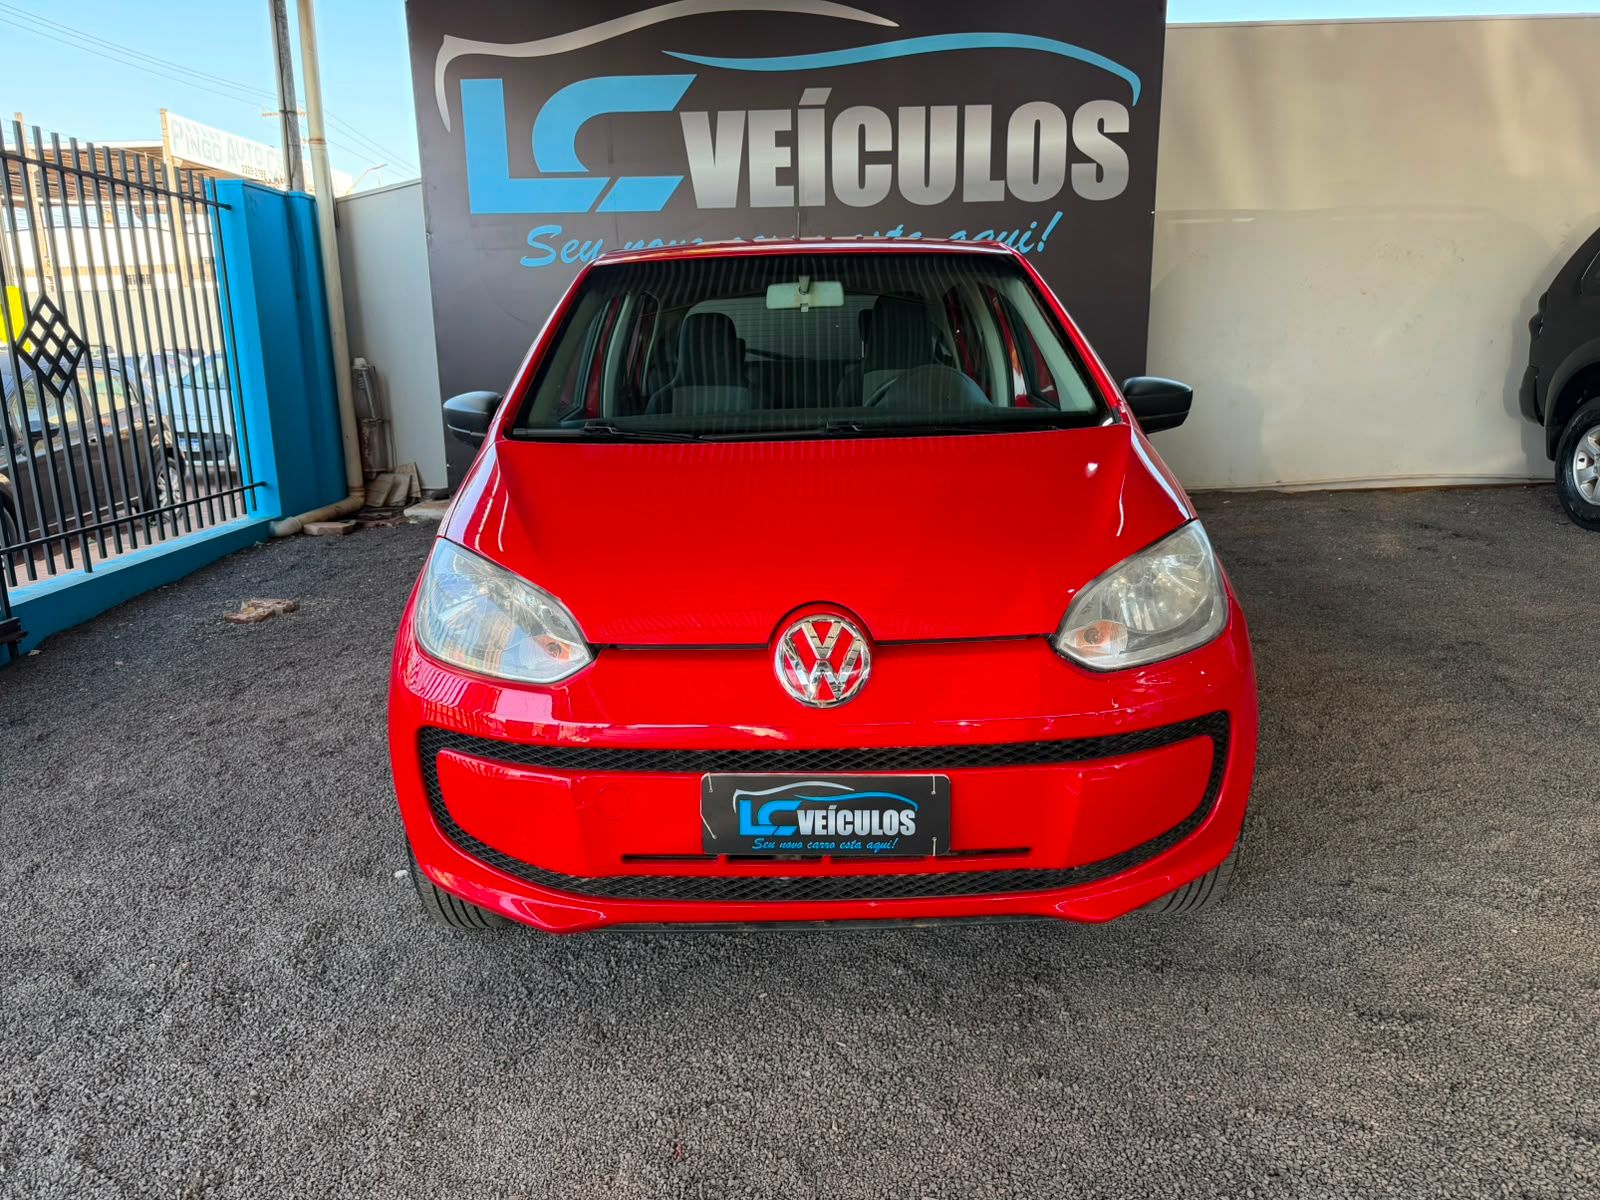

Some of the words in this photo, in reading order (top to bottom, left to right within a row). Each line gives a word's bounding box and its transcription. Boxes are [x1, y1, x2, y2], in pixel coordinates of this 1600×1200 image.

[680, 87, 1131, 209] VEÍCULOS
[797, 805, 917, 836] VEÍCULOS
[752, 837, 775, 849] Seu
[779, 841, 803, 849] novo
[806, 841, 836, 849] carro
[839, 839, 862, 849] esta
[866, 837, 899, 853] aqui!
